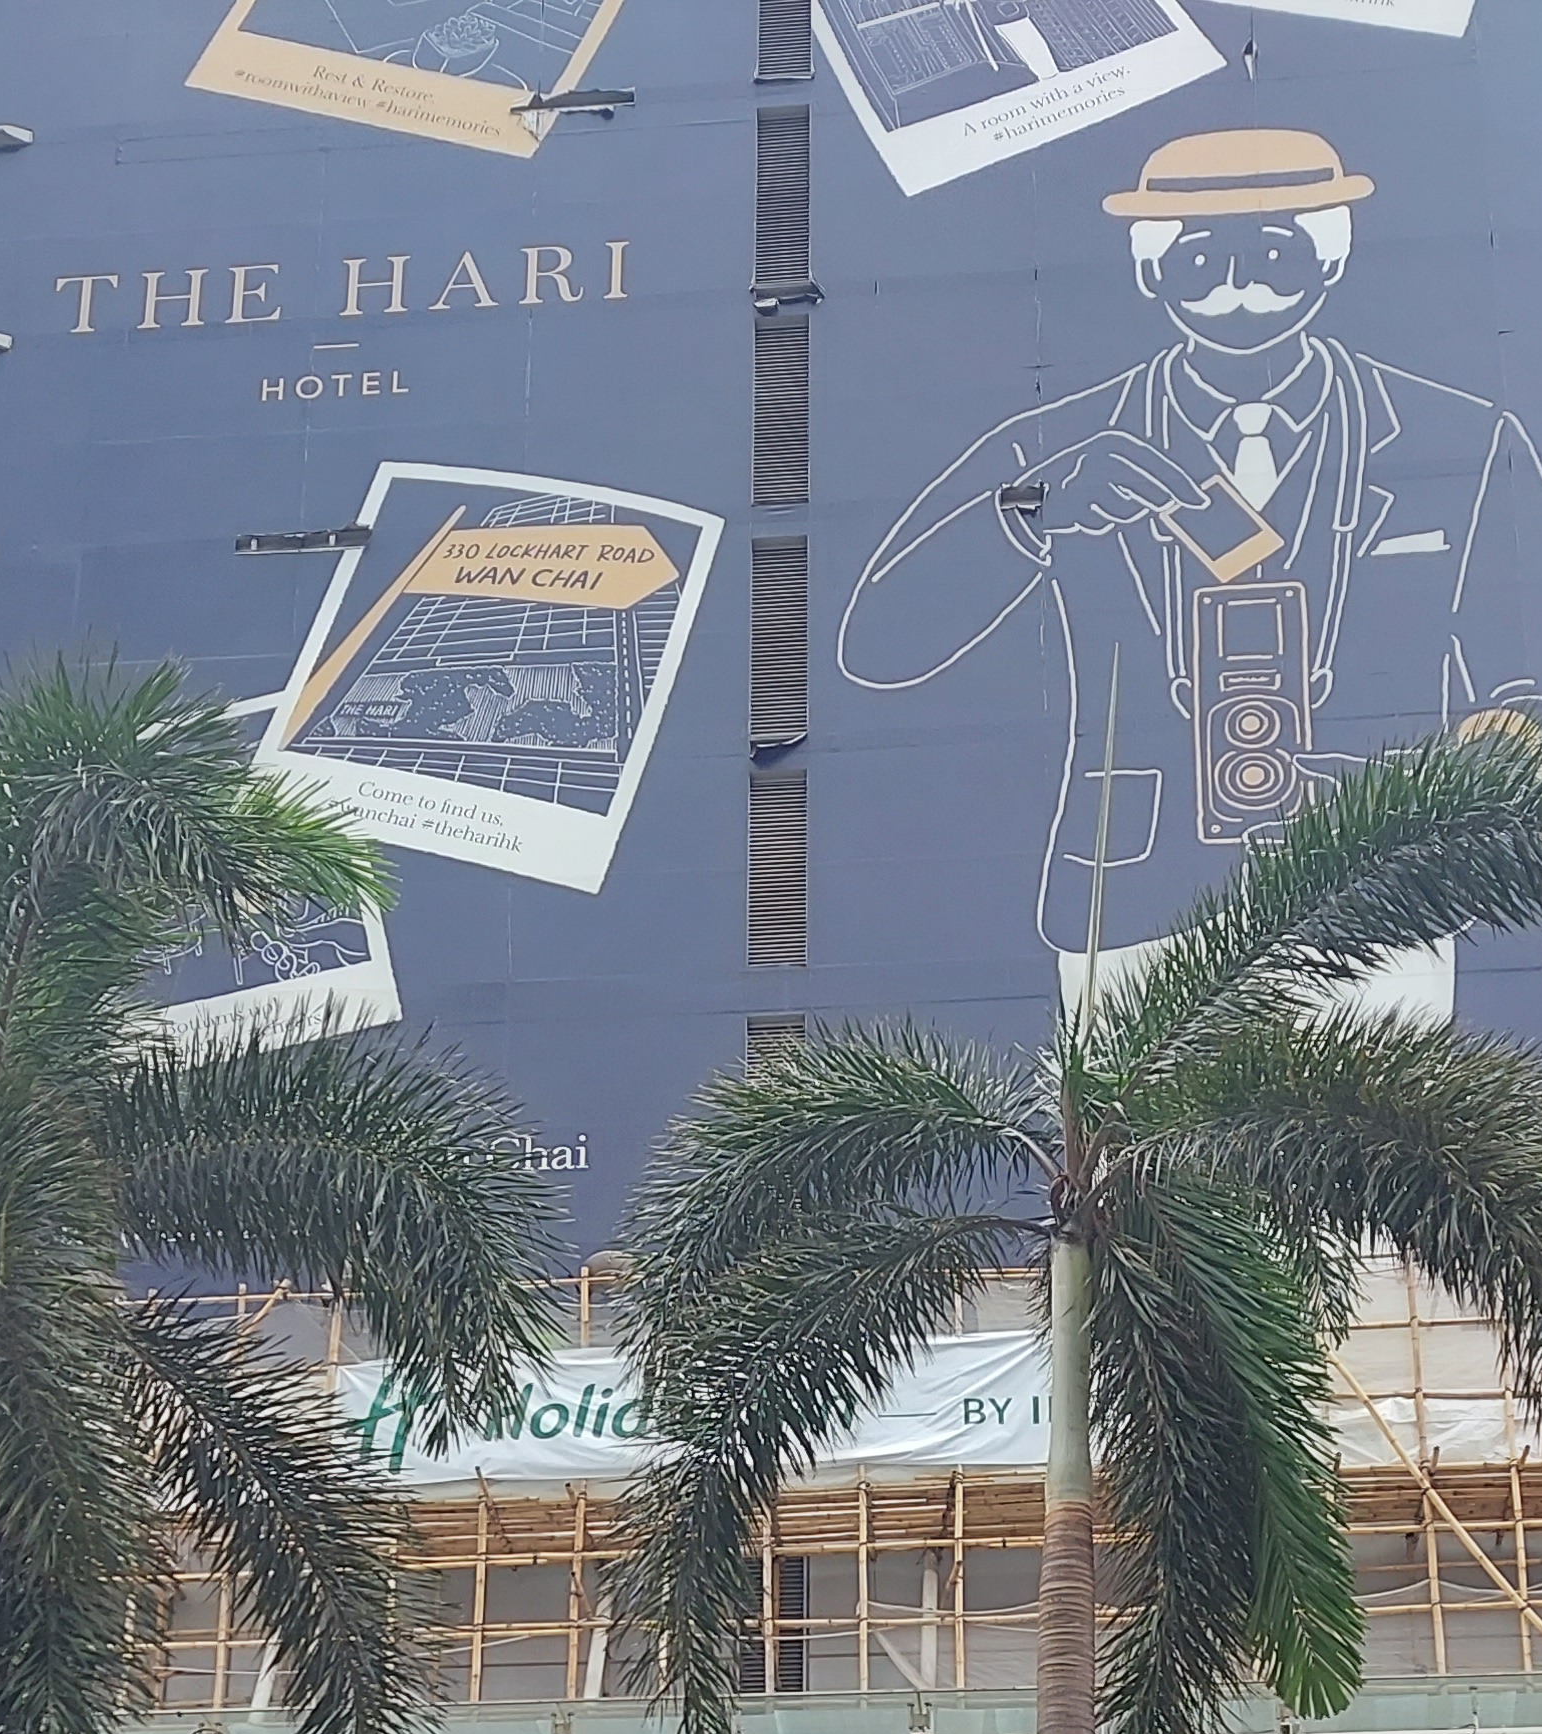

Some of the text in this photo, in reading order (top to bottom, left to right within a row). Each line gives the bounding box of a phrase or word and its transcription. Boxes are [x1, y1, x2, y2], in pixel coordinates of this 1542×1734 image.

[312, 65, 348, 85] Rest
[351, 73, 364, 89] &
[376, 100, 502, 138] #harimemories
[963, 121, 977, 138] A
[980, 105, 1028, 130] room
[1030, 86, 1070, 111] with
[1072, 82, 1084, 95] a
[993, 85, 1127, 142] #harimemories
[56, 240, 630, 333] THE HARI
[261, 370, 410, 402] HOTEL
[442, 543, 656, 564] 330 LOCKHART ROAD
[454, 565, 604, 591] WAN CHAI
[340, 704, 399, 717] THE HARI
[358, 781, 414, 806] Come
[419, 795, 437, 811] to
[440, 798, 478, 820] find
[421, 818, 524, 854] #theharihk
[486, 1134, 590, 1171] Chai
[963, 1397, 1013, 1425] BY
